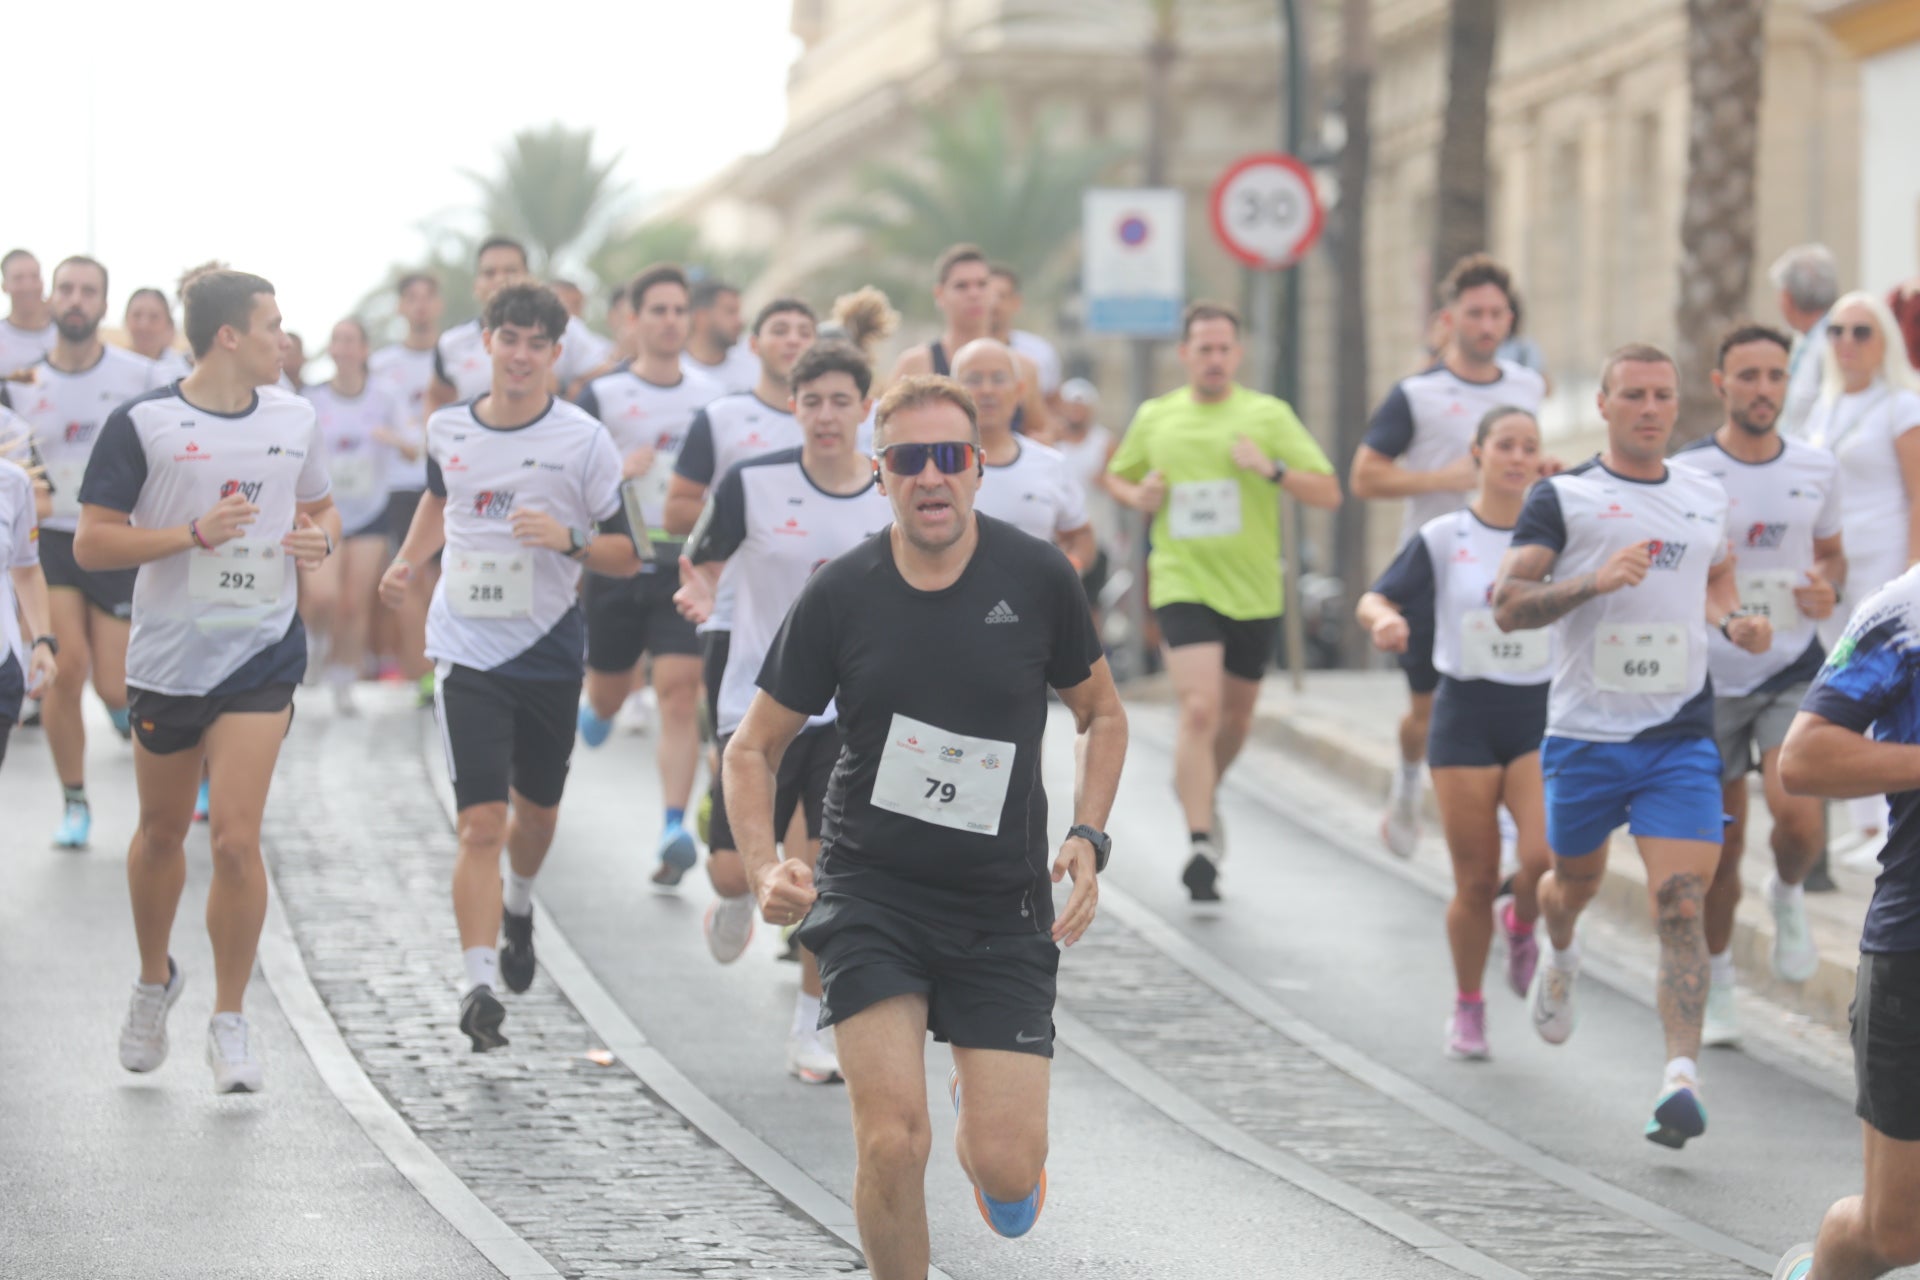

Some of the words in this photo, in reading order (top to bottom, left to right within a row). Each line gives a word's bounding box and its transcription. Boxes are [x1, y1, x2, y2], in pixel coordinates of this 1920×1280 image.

[1236, 187, 1299, 231] 30
[219, 571, 255, 590] 292
[469, 585, 503, 602] 288
[984, 614, 1019, 624] adidas
[1623, 659, 1660, 677] 669
[924, 777, 957, 803] 79
